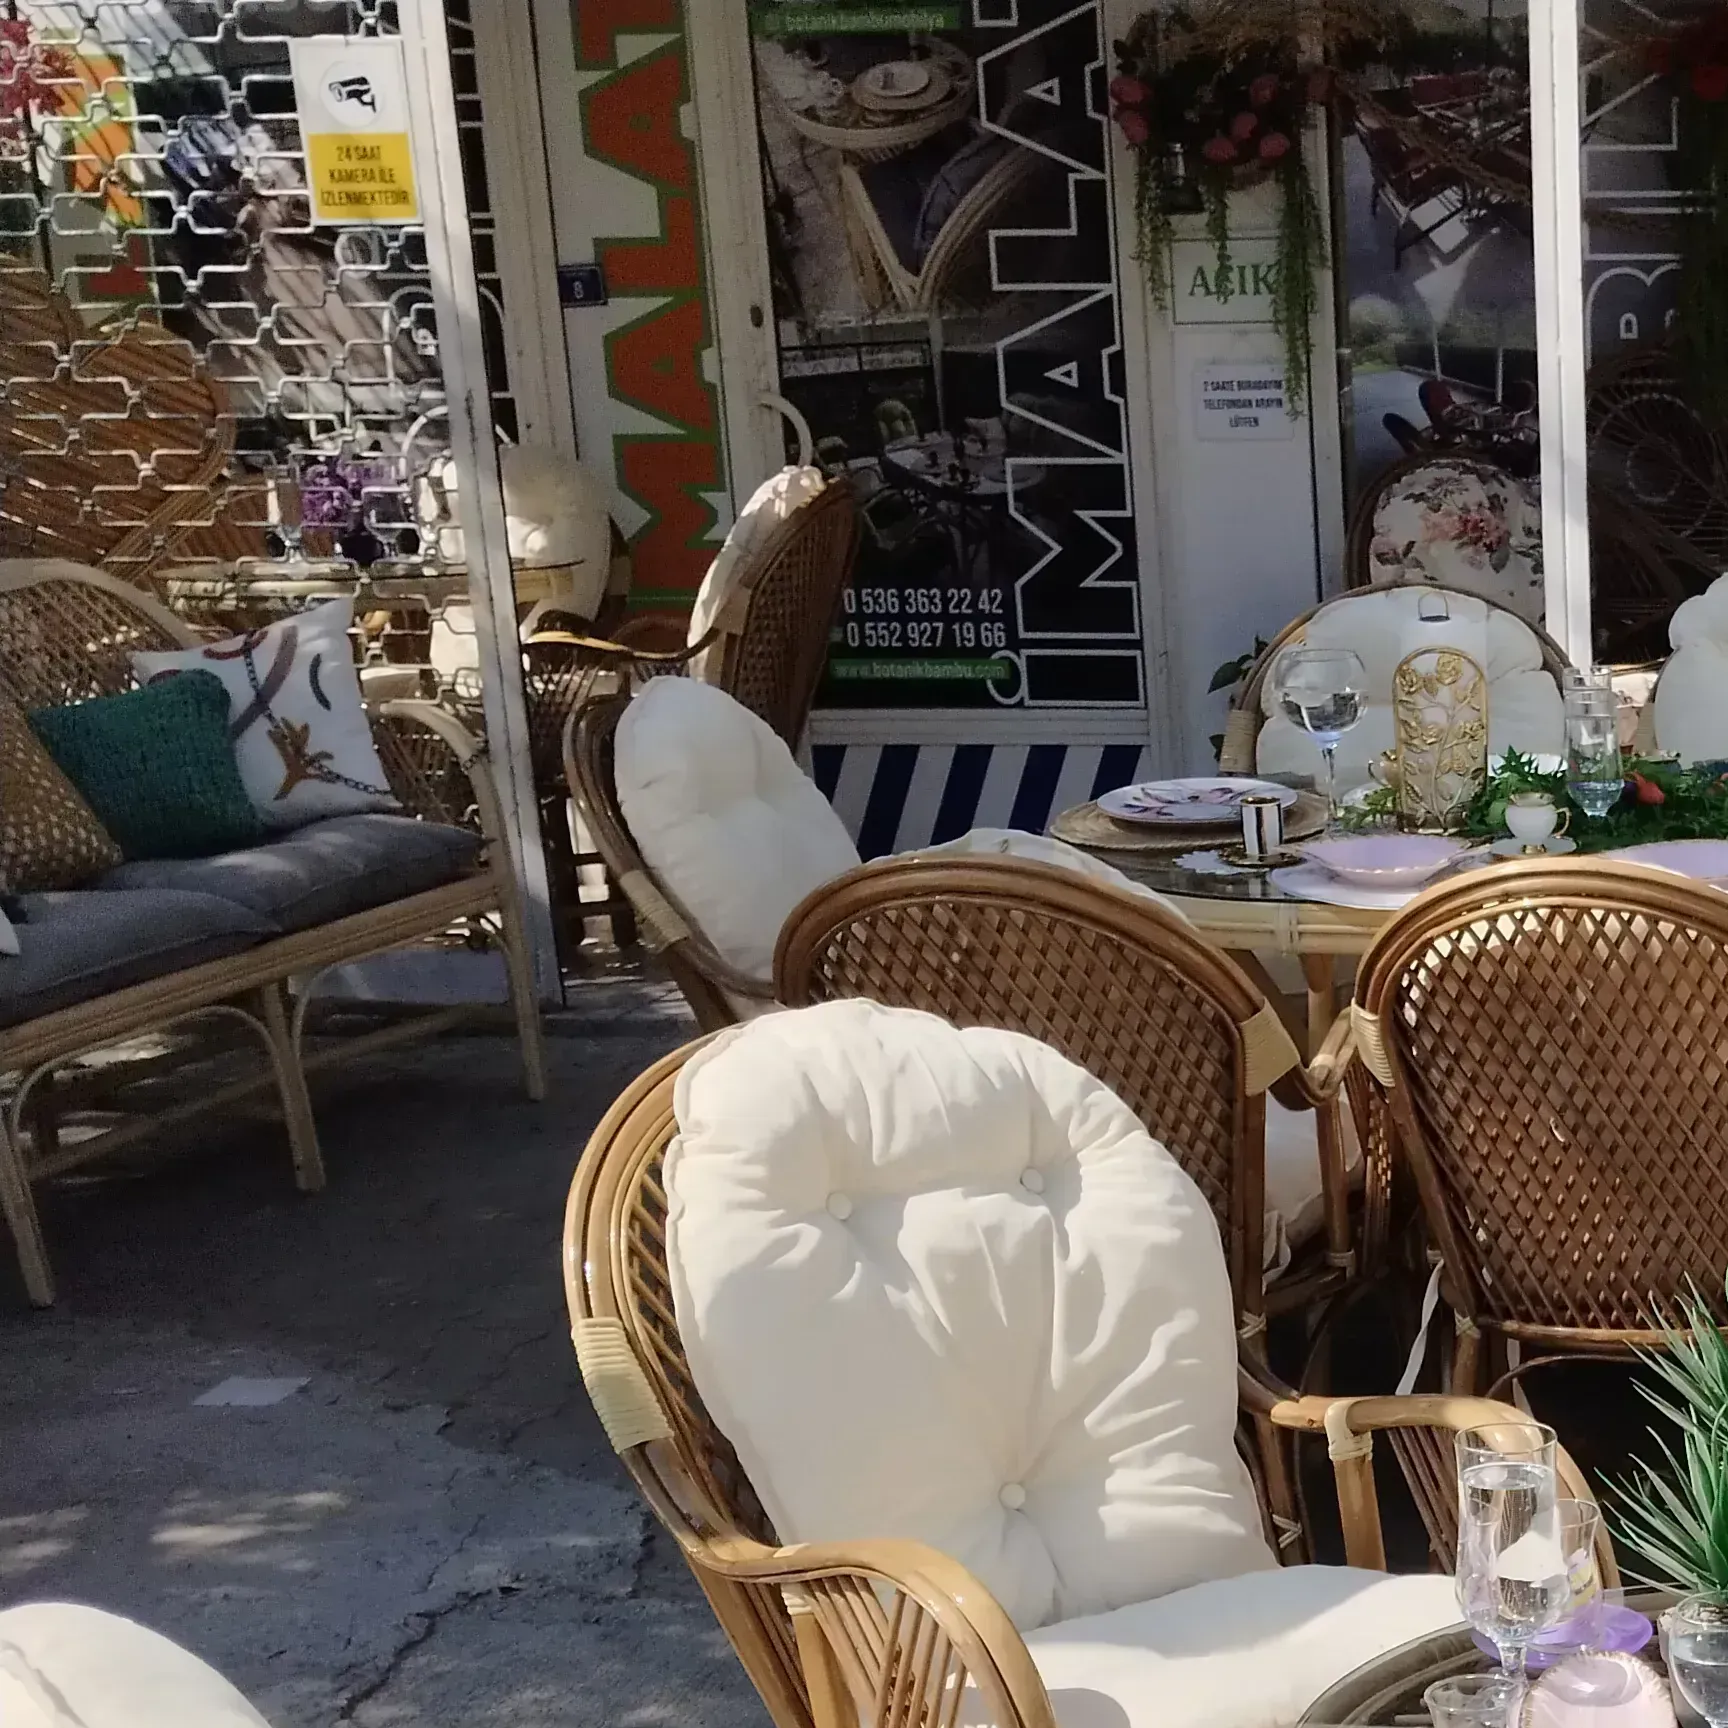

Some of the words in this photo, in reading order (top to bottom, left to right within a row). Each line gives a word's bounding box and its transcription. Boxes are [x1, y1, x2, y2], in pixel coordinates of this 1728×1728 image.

[336, 145, 352, 161] 24
[354, 144, 381, 161] SAAT
[328, 168, 376, 183] KAMERA
[320, 188, 410, 206] İZLENMEKTEDİR
[970, 0, 1148, 708] İMALA
[843, 588, 857, 614] 0
[861, 588, 900, 614] 536
[904, 588, 942, 614] 363
[947, 588, 973, 614] 22
[977, 588, 1003, 614] 42
[846, 622, 860, 647] 0
[864, 622, 903, 647] 552
[907, 622, 944, 647] 927
[951, 622, 976, 647] 19
[980, 622, 1007, 647] 66
